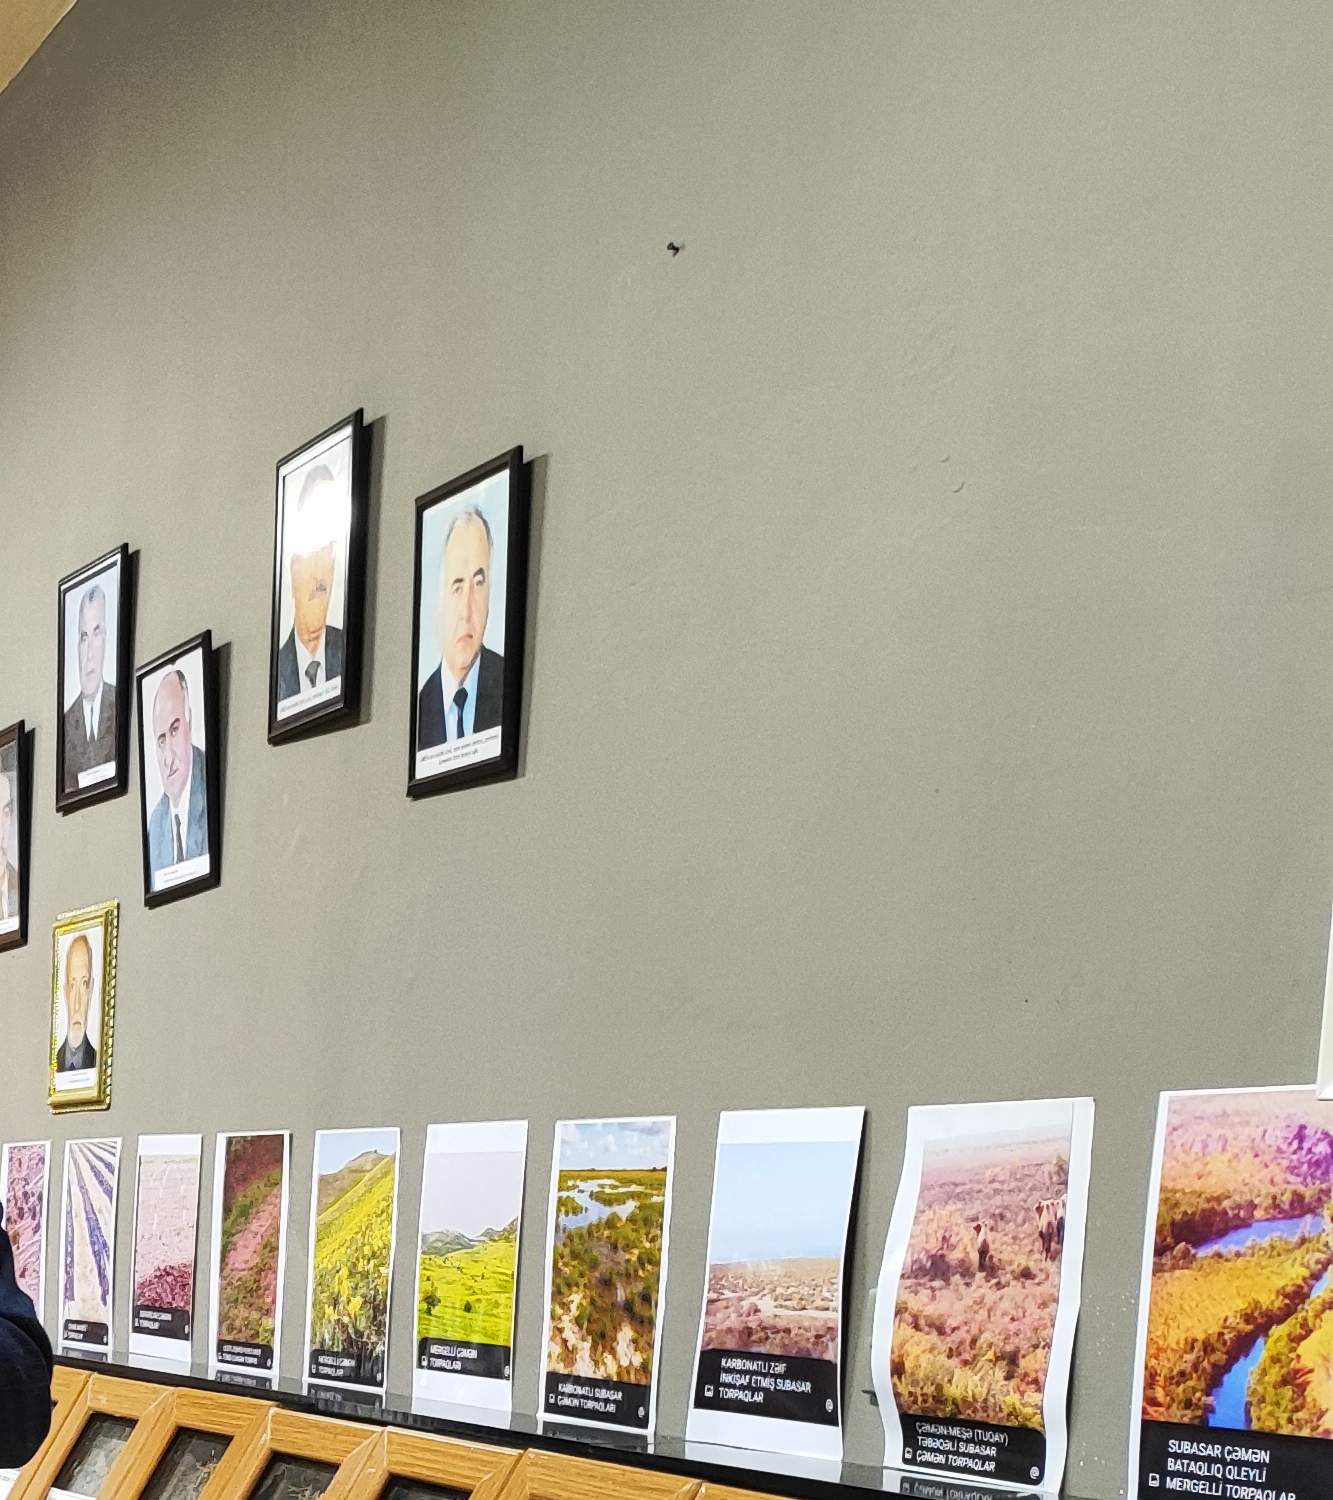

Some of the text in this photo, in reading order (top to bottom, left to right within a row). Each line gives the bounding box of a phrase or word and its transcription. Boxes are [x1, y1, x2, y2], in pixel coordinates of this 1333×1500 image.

[719, 1386, 764, 1404] TORPAQLAR
[776, 1378, 811, 1394] SUBASAR
[974, 1430, 1009, 1447] (TUQAY)
[959, 1442, 997, 1458] SUBASAR
[1168, 1439, 1270, 1464] SUBASAR ÇƏMƏN
[916, 1450, 996, 1473] ÇƏMƏN TORPAQLAR
[1167, 1458, 1267, 1483] BATAQLIQ QLEYLİ
[1166, 1477, 1222, 1497] MERGELLİ
